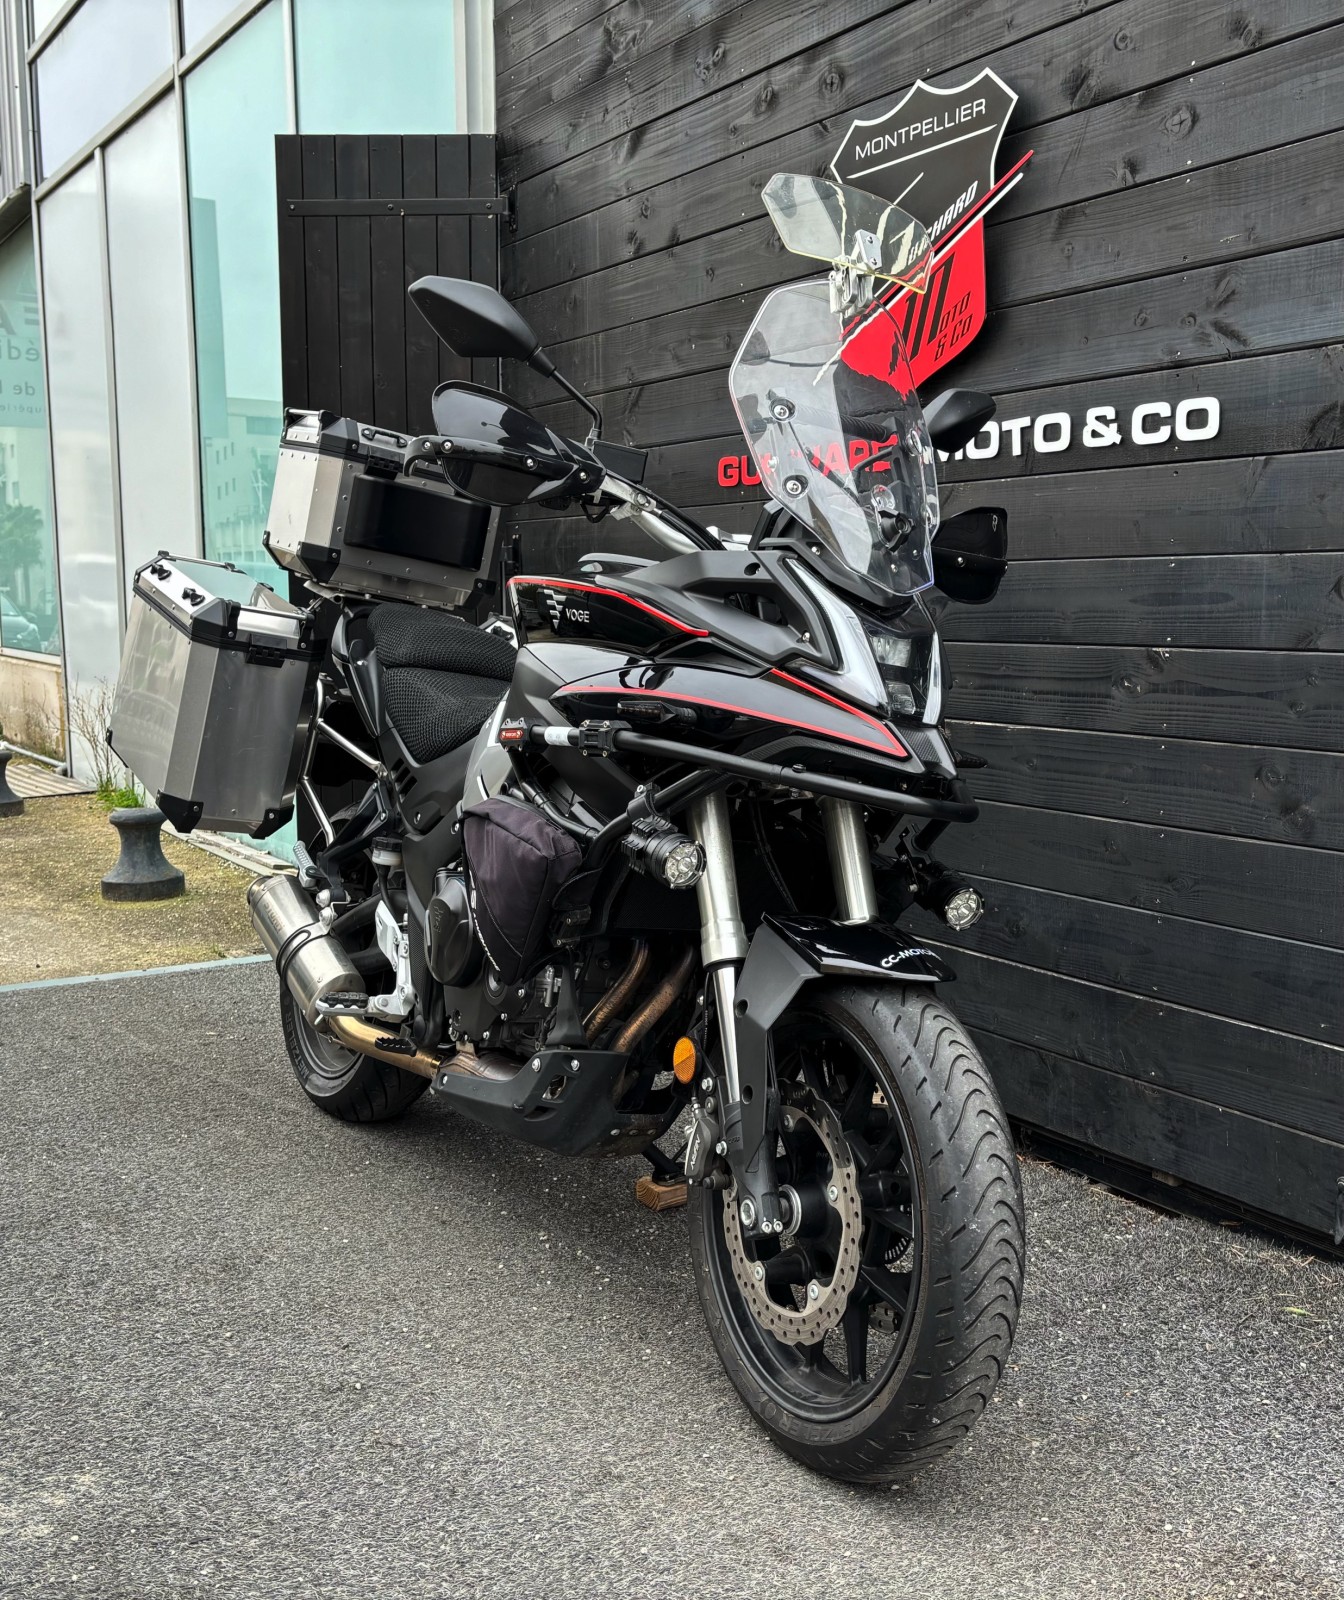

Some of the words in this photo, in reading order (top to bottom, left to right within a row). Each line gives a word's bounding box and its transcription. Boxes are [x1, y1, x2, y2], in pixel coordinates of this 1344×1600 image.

[855, 98, 986, 161] MONTPELLIER
[1082, 405, 1122, 448] &
[1131, 396, 1221, 446] CO
[565, 608, 590, 623] VOGE
